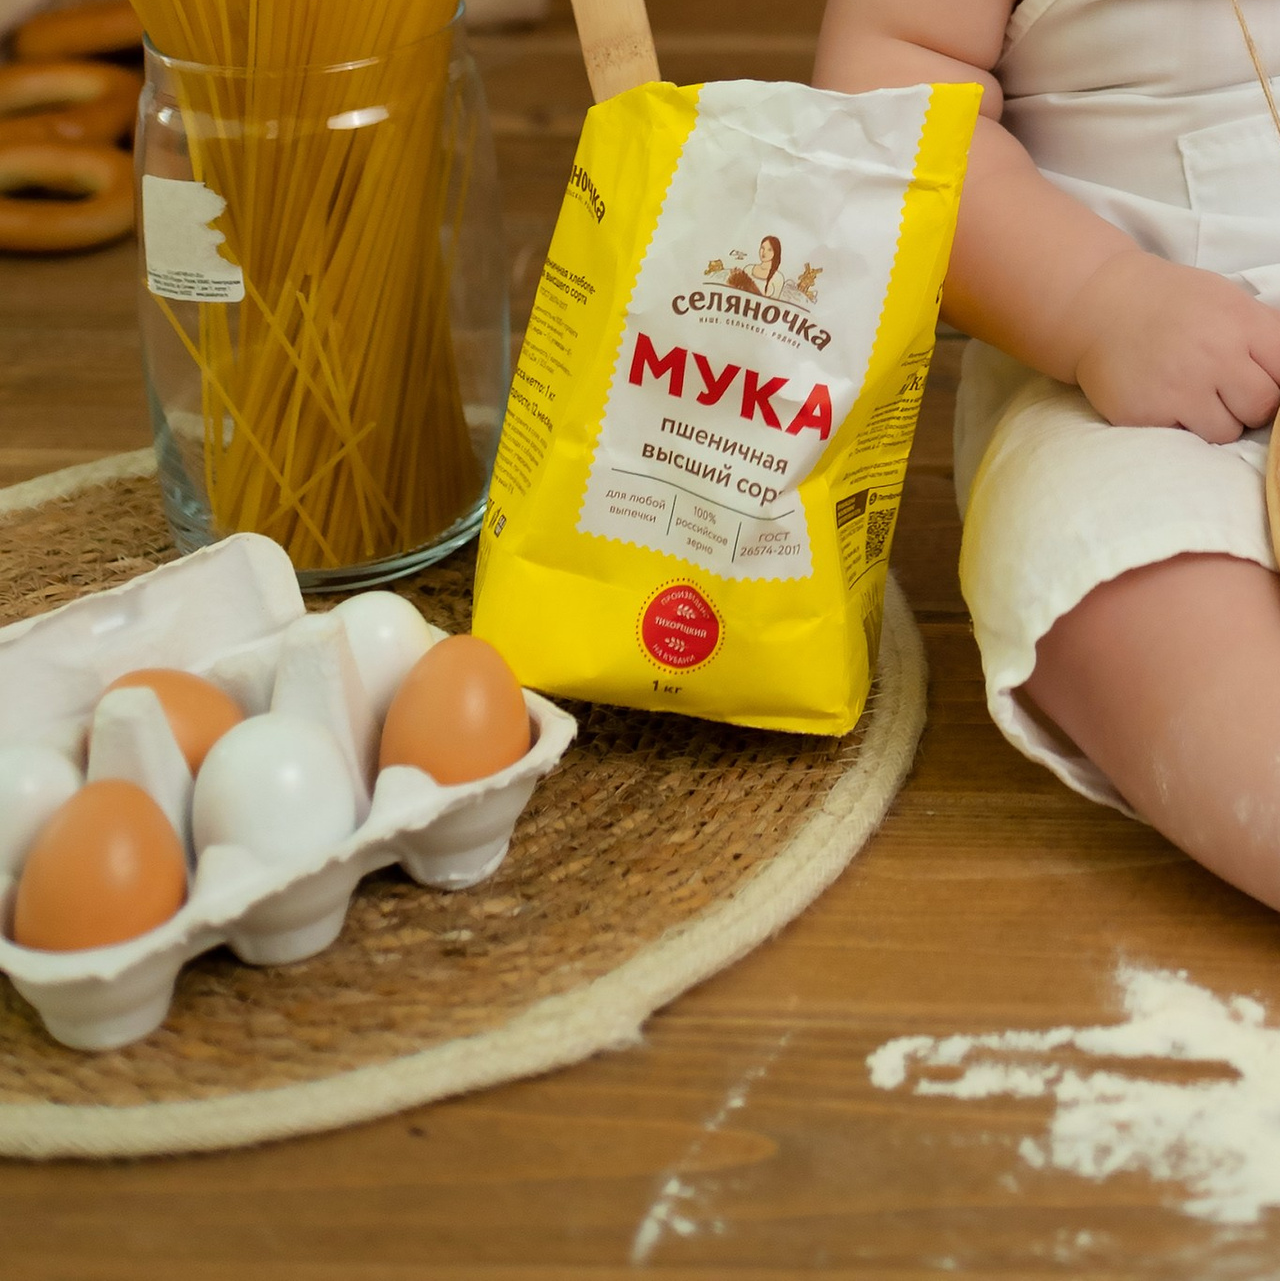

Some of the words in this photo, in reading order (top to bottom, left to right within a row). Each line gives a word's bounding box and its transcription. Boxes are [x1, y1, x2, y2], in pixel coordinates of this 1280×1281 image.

[570, 164, 606, 225] ночка
[671, 290, 832, 352] селяночка
[628, 331, 833, 441] МУКА
[660, 417, 789, 476] пшеничная
[641, 442, 733, 488] высший
[736, 477, 785, 507] сор
[605, 489, 627, 500] для
[629, 493, 666, 511] любой
[609, 505, 657, 524] выпечки
[693, 505, 717, 525] 100%
[675, 516, 729, 547] российское
[757, 531, 791, 543] ГОСТ
[685, 536, 714, 556] зерно
[652, 679, 659, 692] 1
